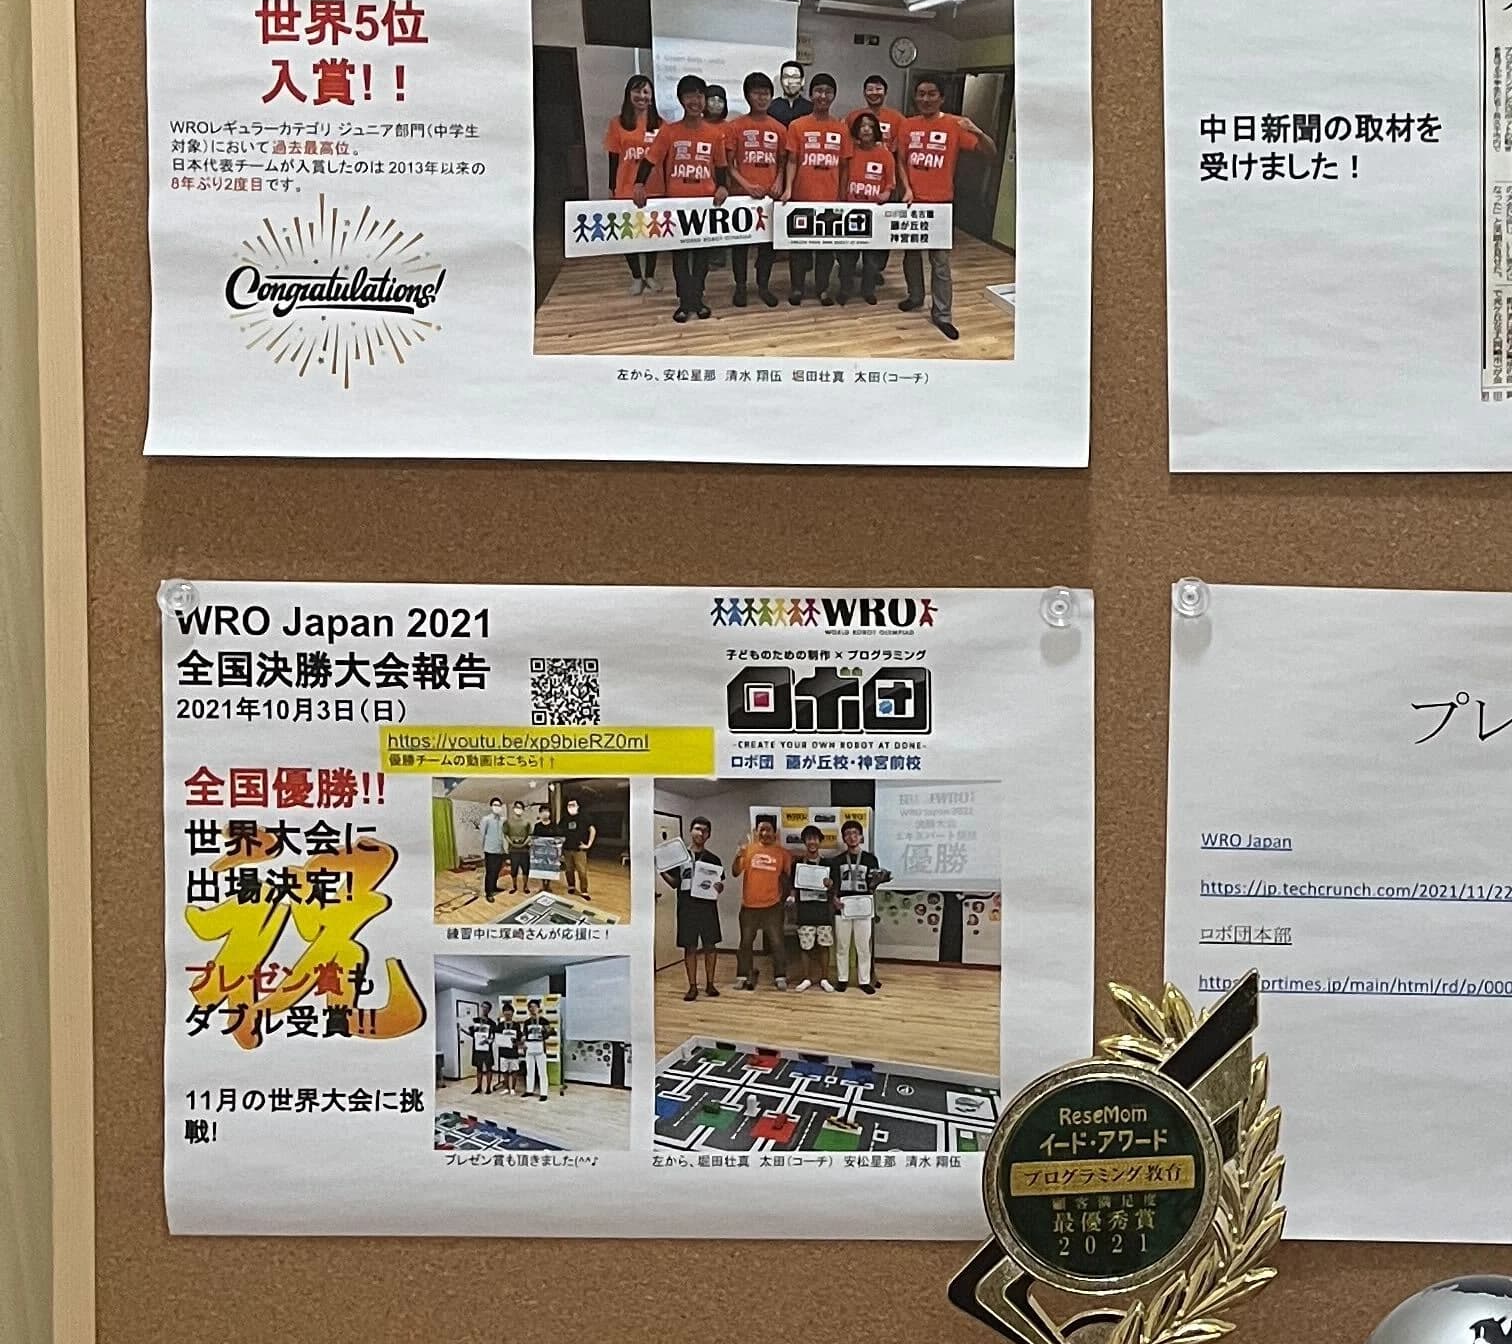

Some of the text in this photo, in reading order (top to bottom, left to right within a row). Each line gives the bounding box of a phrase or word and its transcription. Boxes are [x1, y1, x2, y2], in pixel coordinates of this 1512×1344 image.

[169, 120, 331, 137] WROレギュラーカテゴリ
[1200, 113, 1443, 144] 中日新聞の取材を
[1200, 151, 1359, 182] 受けました！
[676, 206, 753, 238] WRO
[225, 265, 447, 318] Congratulations!
[176, 605, 490, 644] WRO Japan 2021
[821, 598, 917, 627] WRO
[177, 649, 491, 690] 全国決勝大会報告
[176, 697, 408, 723] 2021年10月3日（日）
[731, 755, 774, 770] ロボ団
[184, 766, 386, 808] 全国優勝!!
[184, 819, 379, 856] 世界大会に
[1201, 832, 1293, 851] WRO Japan
[187, 867, 354, 905] 出場決定!
[1199, 925, 1292, 945] ロボ団本部
[185, 961, 375, 997] プレゼン賞も
[185, 1005, 378, 1038] ダブル受賞!!
[185, 1087, 425, 1113] 11月の世界大会に挑
[1059, 1106, 1148, 1126] ReseMom
[1039, 1128, 1169, 1156] イード・アワード
[1024, 1162, 1182, 1187] プログラミング教育
[1058, 1233, 1149, 1256] 2021
